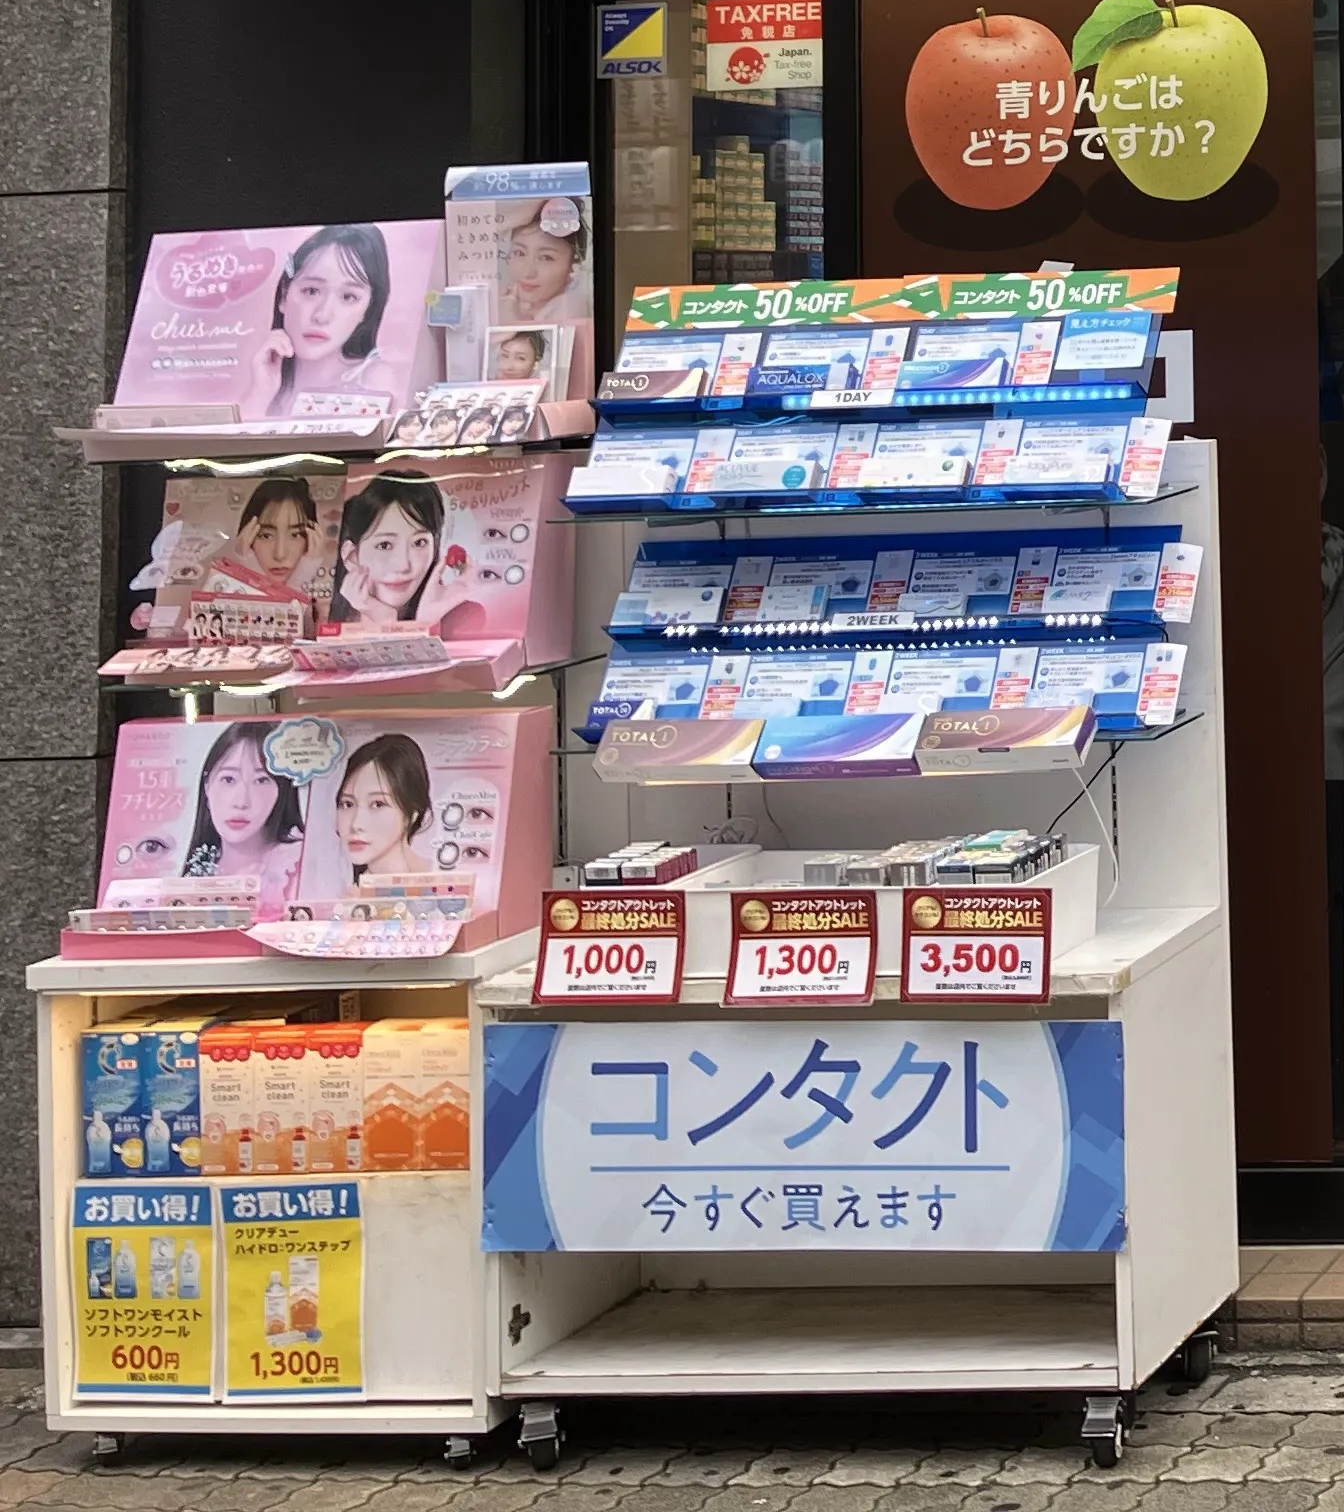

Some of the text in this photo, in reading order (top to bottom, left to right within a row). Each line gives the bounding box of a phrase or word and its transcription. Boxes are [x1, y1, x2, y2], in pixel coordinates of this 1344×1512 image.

[715, 2, 821, 24] TAXFREE
[778, 48, 812, 57] Japan.
[602, 61, 662, 75] ALSOK
[788, 70, 812, 80] Shop
[996, 74, 1183, 119] 青りんごは
[961, 121, 1217, 167] どちらですか？
[953, 289, 1021, 305] コンタクト
[683, 299, 749, 315] コンタクト
[835, 392, 871, 403] 1DAY
[847, 614, 899, 627] 2WEEK
[581, 898, 675, 911] コンタクトアウトレット
[772, 899, 867, 912] コンタクトアウトレット
[944, 897, 1041, 909] コンタクトアウトレット
[563, 943, 657, 978] 1,000円
[755, 943, 850, 979] 1,300円
[920, 943, 1032, 978] 3,500円
[590, 1038, 1009, 1154] コンタクト
[642, 1183, 957, 1233] 今すぐ買えます
[235, 1228, 299, 1239] クリアデュー
[84, 1308, 203, 1322] ソフトワンモイスト
[86, 1324, 191, 1339] ソフトワンクール
[111, 1344, 180, 1370] 600円
[250, 1350, 339, 1378] 1,300円
